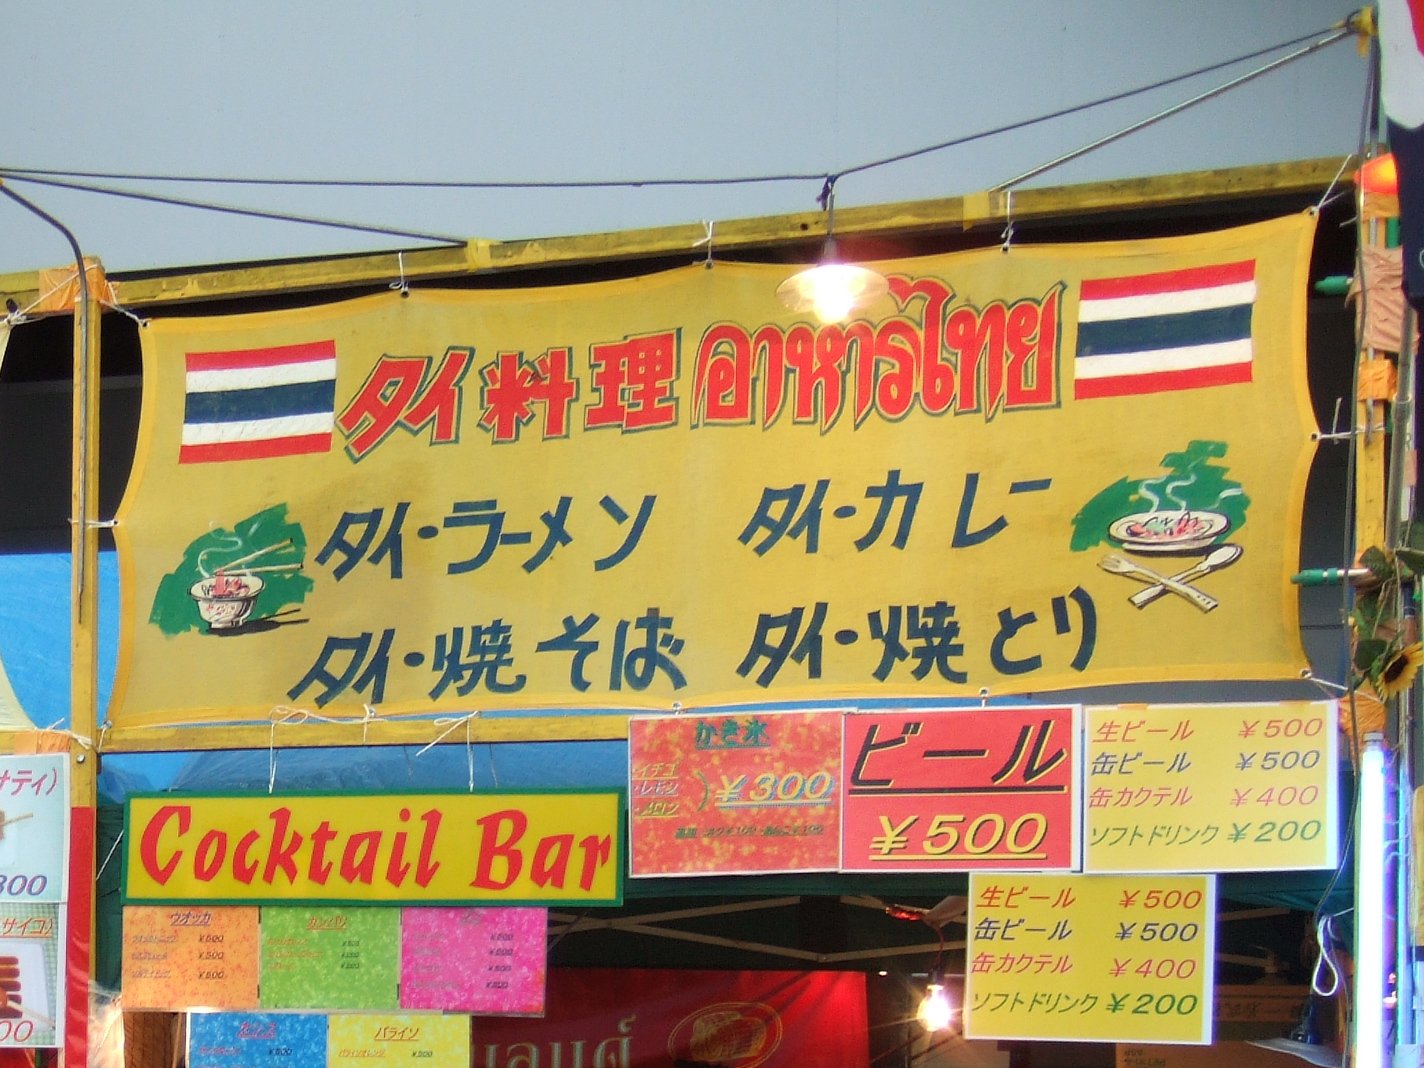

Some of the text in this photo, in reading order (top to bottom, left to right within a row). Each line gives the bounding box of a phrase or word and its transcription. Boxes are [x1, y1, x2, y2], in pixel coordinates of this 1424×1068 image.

[337, 327, 682, 463] タイ料理
[695, 719, 771, 748] かき氷
[1092, 718, 1323, 743] 生ビール ¥500
[851, 721, 1068, 786] ビール
[1091, 750, 1322, 777] 缶ビール ¥500
[715, 771, 835, 804] ¥300
[1089, 784, 1320, 809] 缶カクテル ¥400
[869, 813, 1048, 857] ¥500
[1090, 820, 1322, 847] ソフトドリンク ¥200
[140, 805, 612, 892] Cocktail Bar
[975, 886, 1202, 910] 生ビール ¥500
[973, 918, 1198, 943] 缶ビール ¥500
[971, 952, 1197, 980] 缶カクテル ¥400
[972, 992, 1198, 1017] ソフトドリンク ¥200
